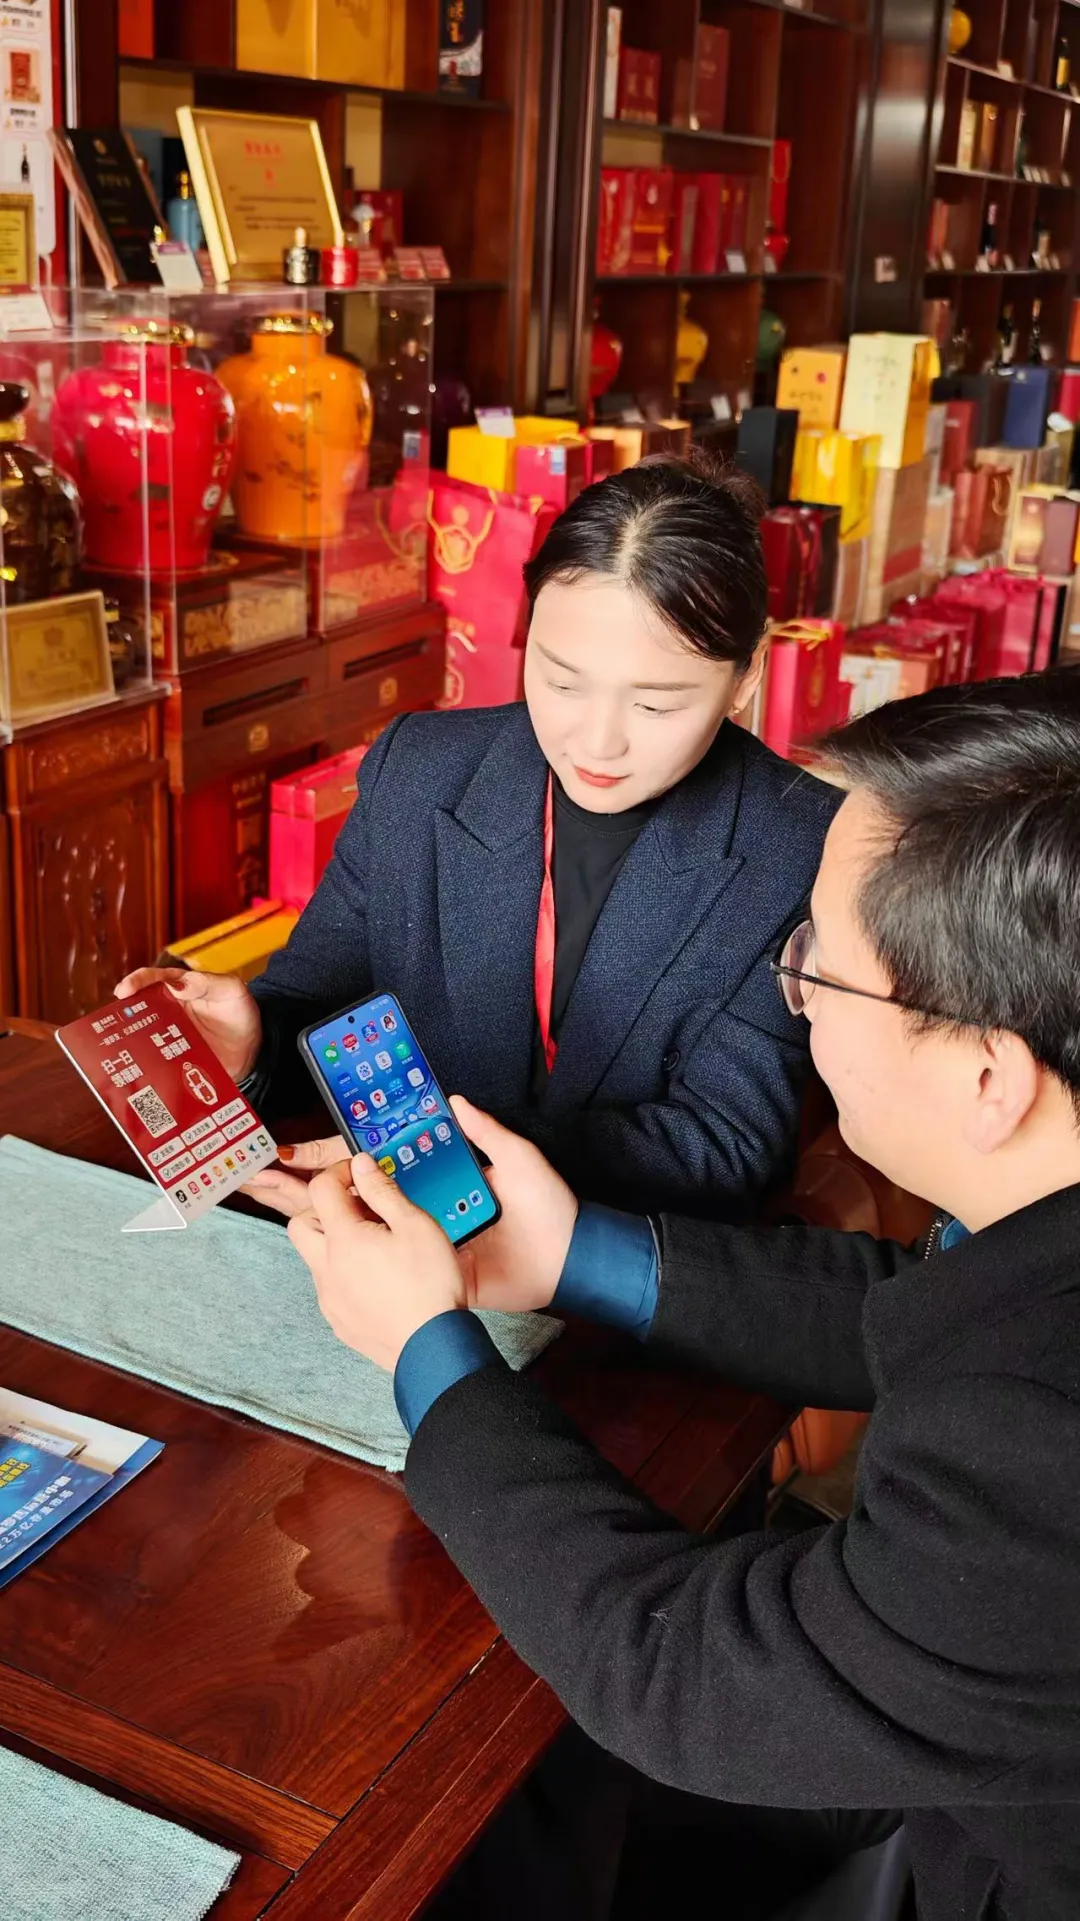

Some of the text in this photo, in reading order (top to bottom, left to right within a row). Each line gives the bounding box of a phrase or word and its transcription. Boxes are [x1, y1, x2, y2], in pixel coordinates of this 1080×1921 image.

[150, 1024, 182, 1047] 碰一碰
[160, 1037, 191, 1060] 领福利
[101, 1050, 134, 1074] 扫一扫
[111, 1063, 144, 1088] 领福利
